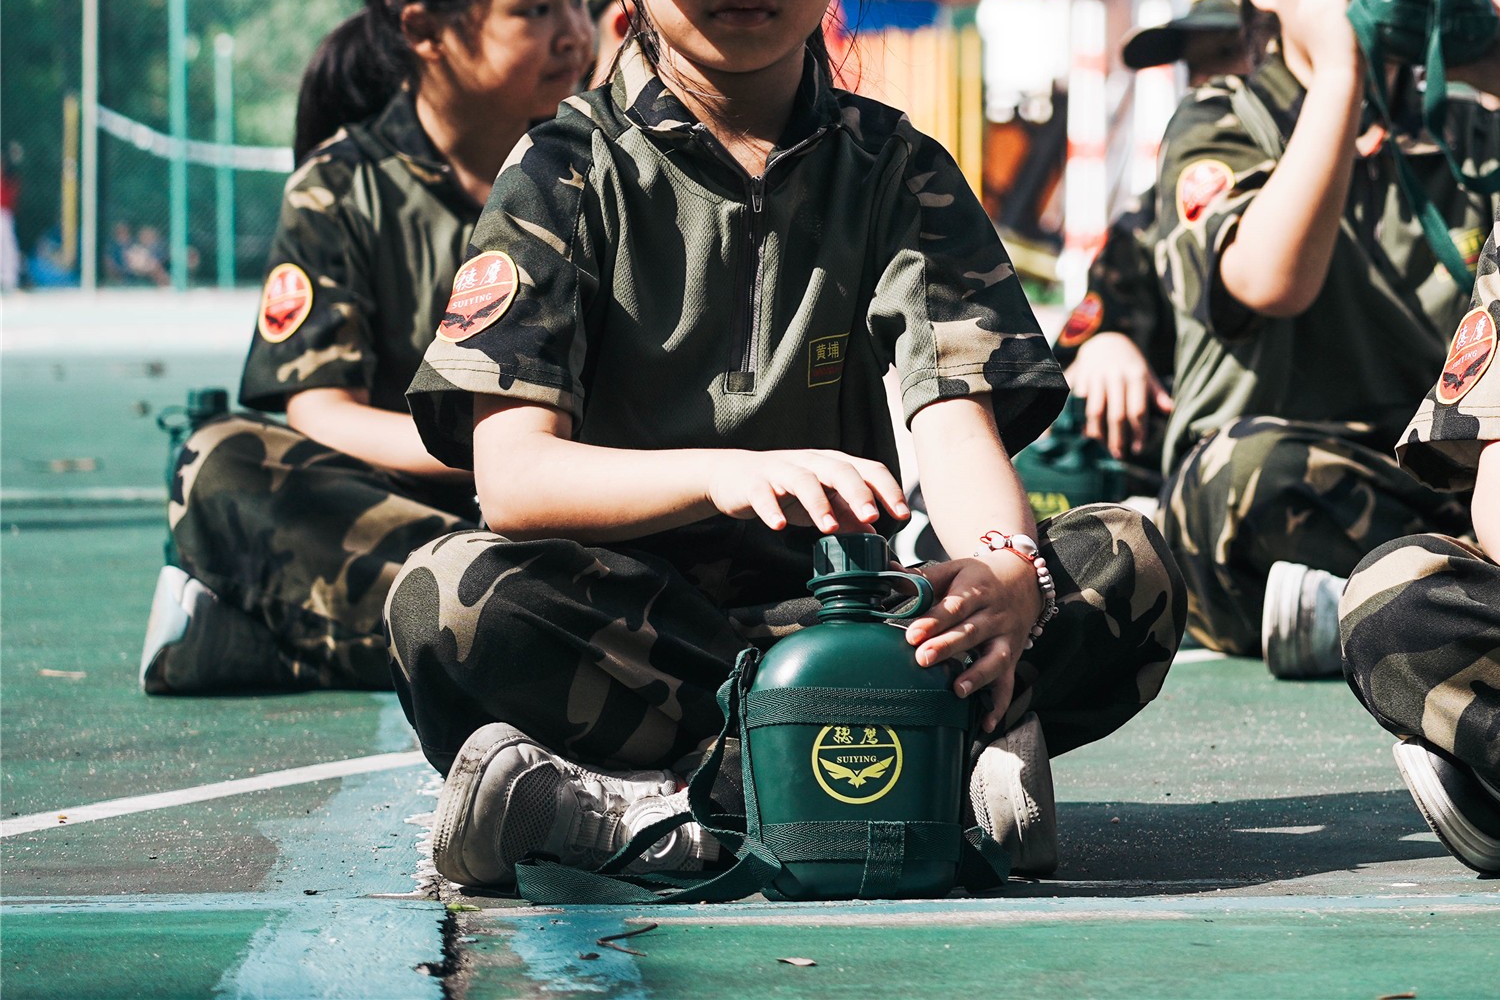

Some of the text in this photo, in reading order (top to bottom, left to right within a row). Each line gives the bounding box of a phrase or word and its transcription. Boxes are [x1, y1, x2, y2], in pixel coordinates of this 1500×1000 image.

[452, 293, 492, 309] SUIYING
[816, 341, 840, 360] 黄埔
[836, 755, 877, 764] SUIYING
